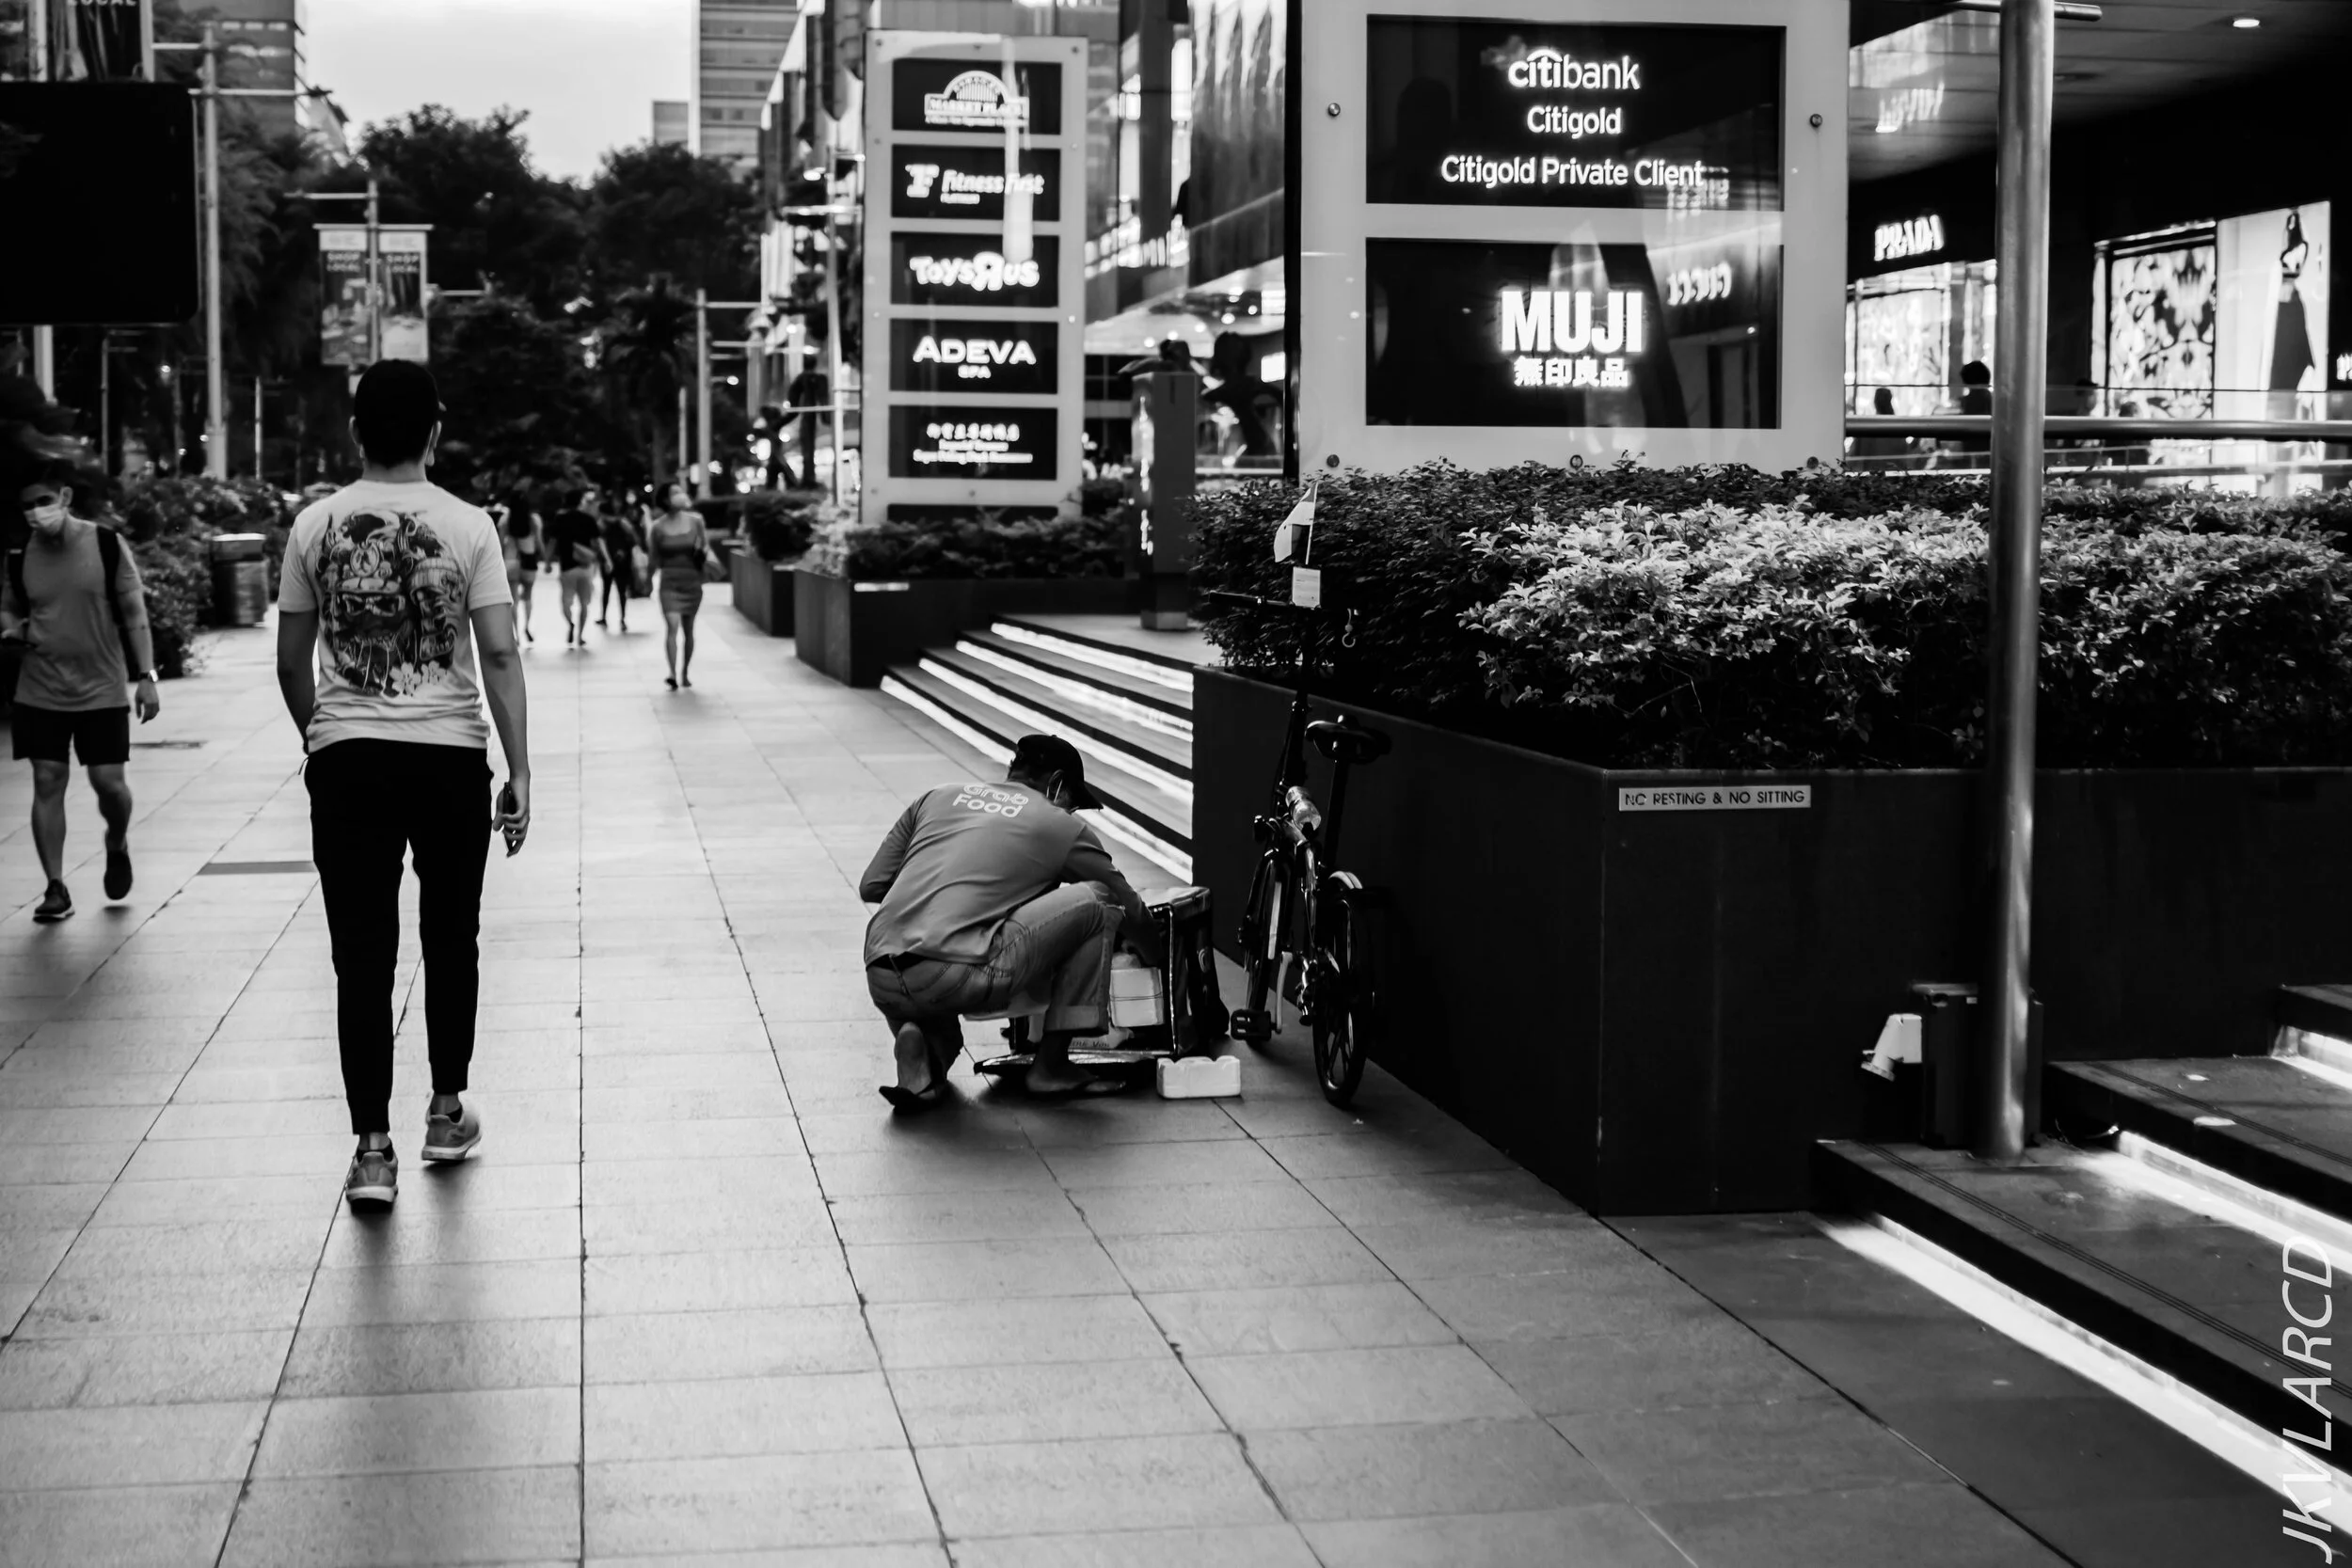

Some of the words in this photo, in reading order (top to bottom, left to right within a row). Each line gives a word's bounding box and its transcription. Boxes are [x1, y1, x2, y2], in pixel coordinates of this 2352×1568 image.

[1507, 47, 1641, 90] citibank
[1527, 105, 1622, 139] Citigold
[1440, 155, 1535, 188] Citigold
[1542, 157, 1628, 185] Private
[1634, 159, 1704, 186] Client
[1874, 214, 1945, 261] PRADA
[1501, 291, 1644, 354] MUJI
[912, 335, 1037, 365] ADEVA
[1513, 355, 1630, 388] 無印良品
[952, 793, 1024, 818] Food
[963, 784, 1029, 805] Grab
[1653, 792, 1707, 805] RESTING
[1712, 793, 1723, 804] &
[1729, 791, 1751, 803] NO
[1756, 790, 1805, 803] SITTING
